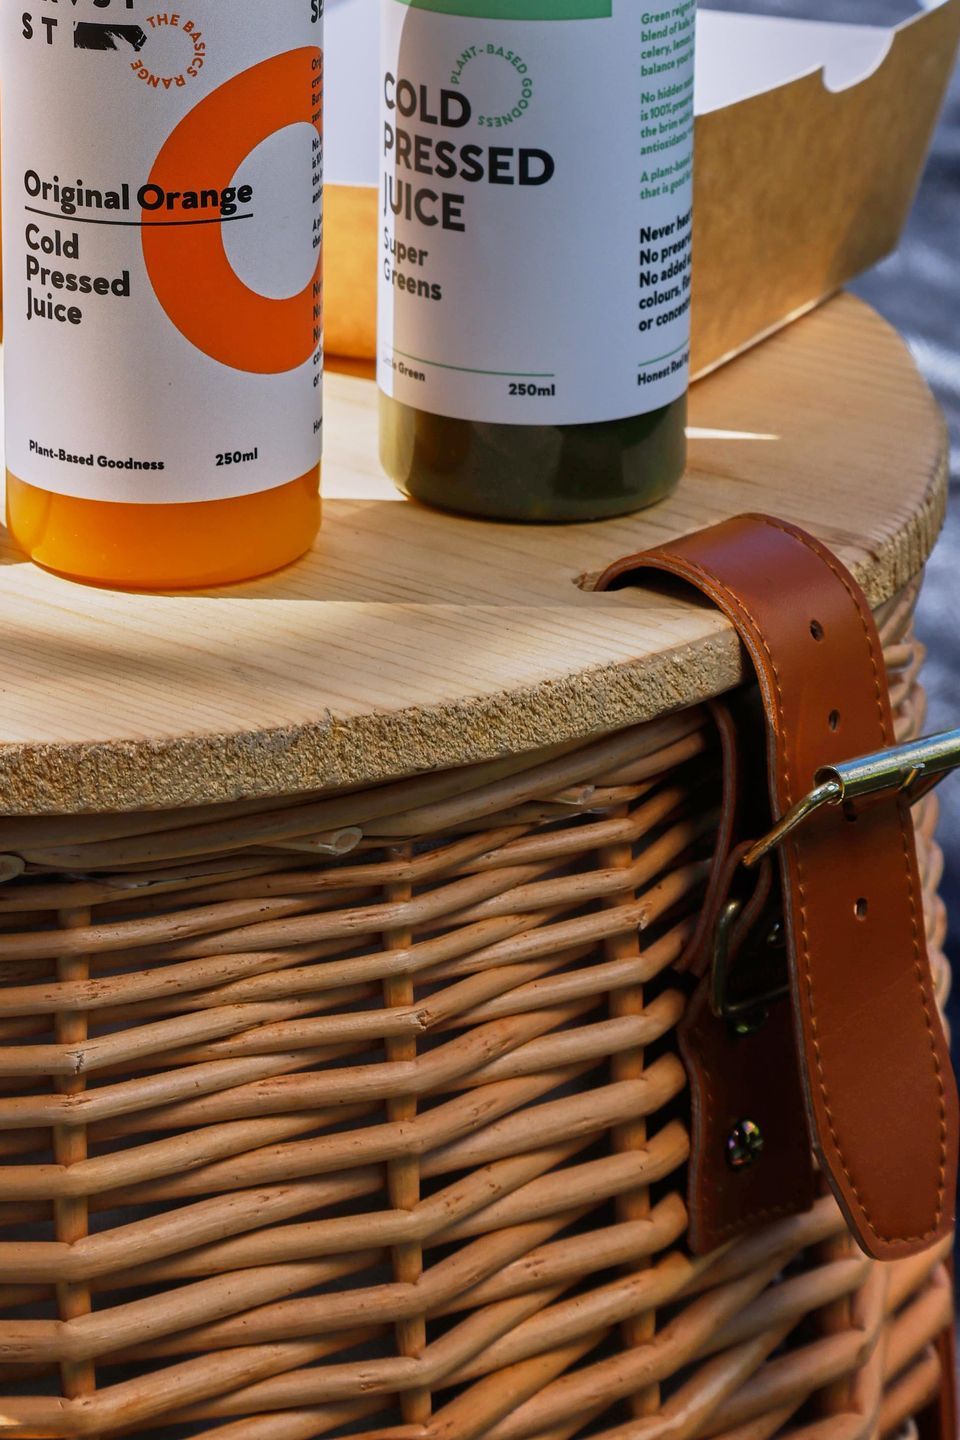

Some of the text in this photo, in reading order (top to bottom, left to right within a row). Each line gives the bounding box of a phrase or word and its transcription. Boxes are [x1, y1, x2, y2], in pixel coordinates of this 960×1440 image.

[22, 12, 58, 45] ST
[641, 10, 671, 26] Green
[641, 25, 668, 42] blend
[669, 21, 677, 35] of
[130, 13, 206, 90] THE BASICS RANGE
[641, 44, 672, 60] celery,
[641, 60, 676, 77] balance
[384, 71, 472, 128] COLD
[477, 77, 533, 128] GOODNESS
[641, 91, 655, 105] No
[657, 83, 683, 100] hidden
[641, 109, 649, 122] is
[640, 125, 657, 139] the
[659, 119, 678, 134] brim
[384, 120, 555, 186] PRESSED
[640, 170, 649, 183] A
[24, 169, 254, 216] Original Orange
[384, 172, 466, 232] JUICE
[640, 187, 661, 200] that
[662, 181, 669, 194] is
[25, 223, 80, 260] Cold
[639, 221, 675, 244] Never
[384, 227, 428, 266] Super
[639, 248, 659, 266] No
[26, 254, 131, 298] Pressed
[384, 258, 442, 301] Greens
[639, 270, 659, 289] No
[661, 257, 687, 281] added
[27, 287, 83, 325] Juice
[638, 285, 682, 310] colours,
[638, 318, 654, 332] or
[398, 361, 426, 383] Green
[637, 365, 671, 387] Honest
[508, 382, 556, 397] 250ml
[29, 439, 165, 471] Plant-Based Goodness
[215, 447, 258, 467] 250ml
